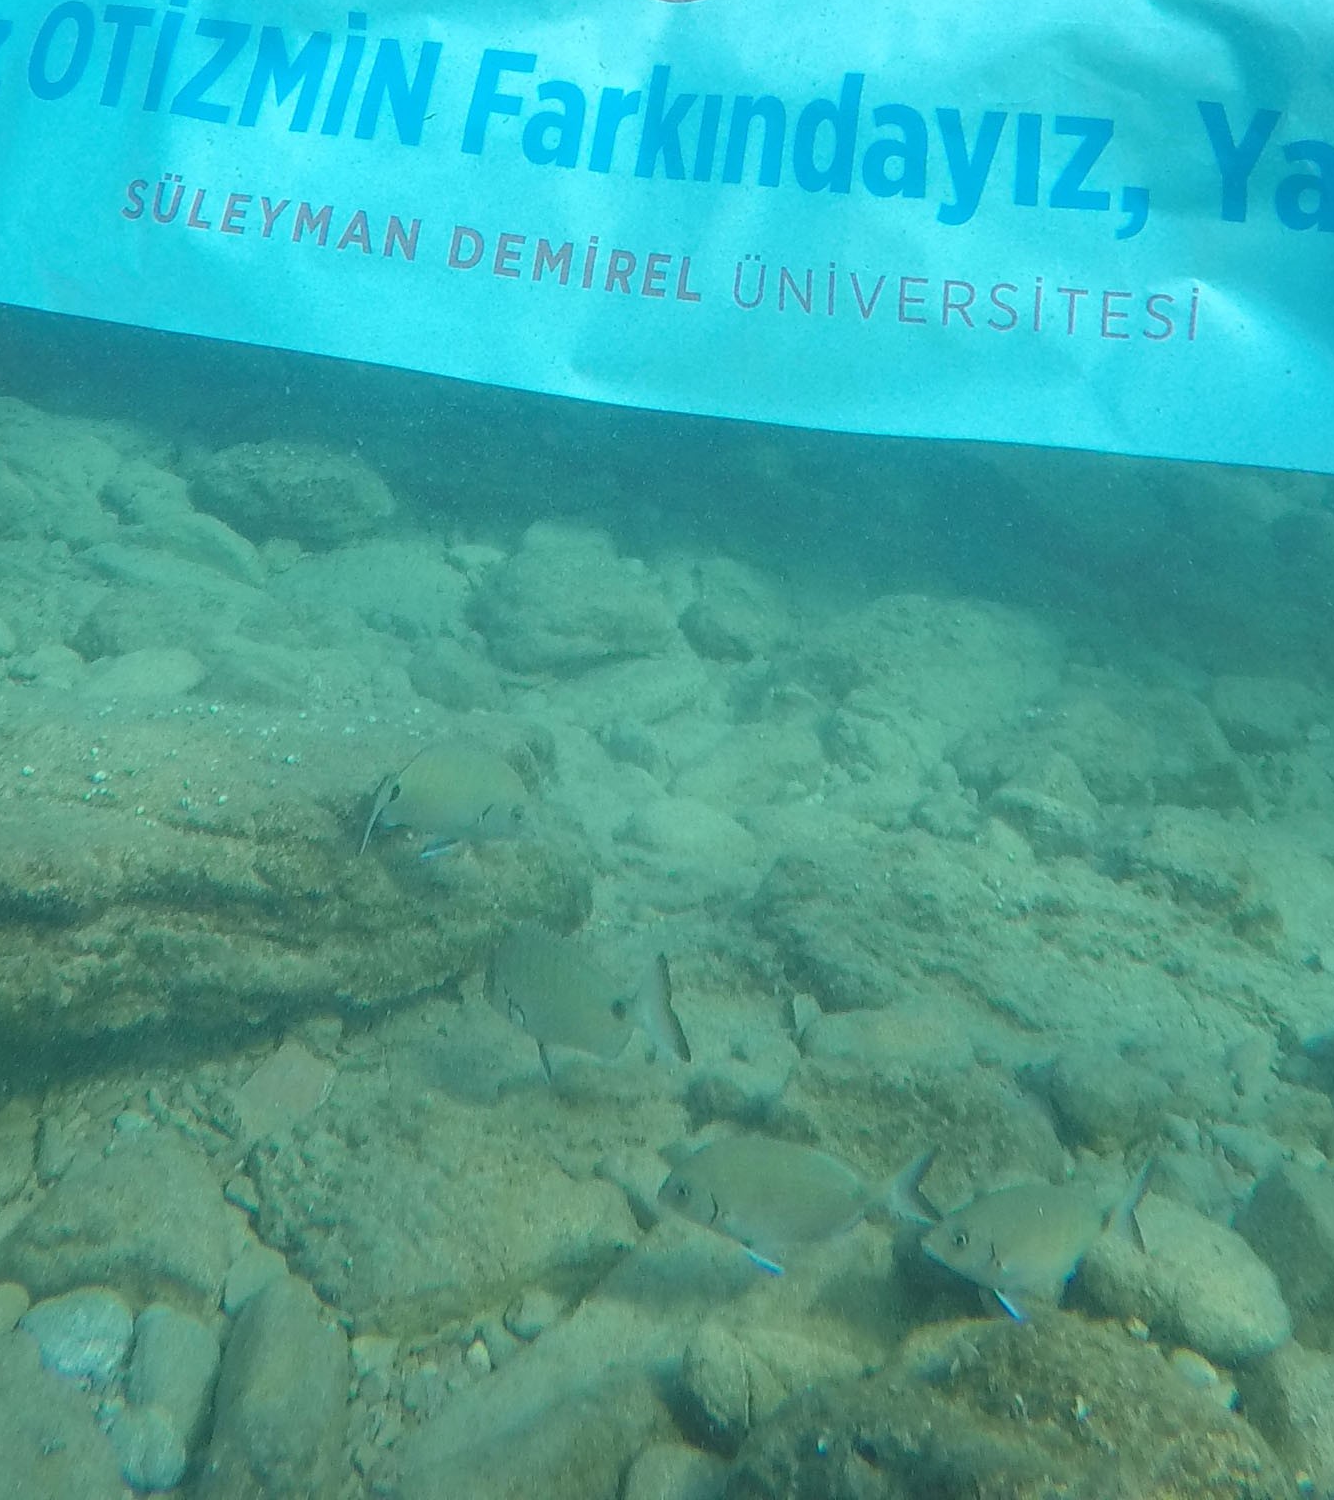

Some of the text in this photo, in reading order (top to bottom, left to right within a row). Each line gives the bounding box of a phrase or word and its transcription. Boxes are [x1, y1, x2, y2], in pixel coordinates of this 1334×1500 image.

[465, 48, 1151, 240] Farkındayız,
[121, 174, 1200, 342] SÜLEYMAN DEMİREL ÜNİVERSİTESİ
